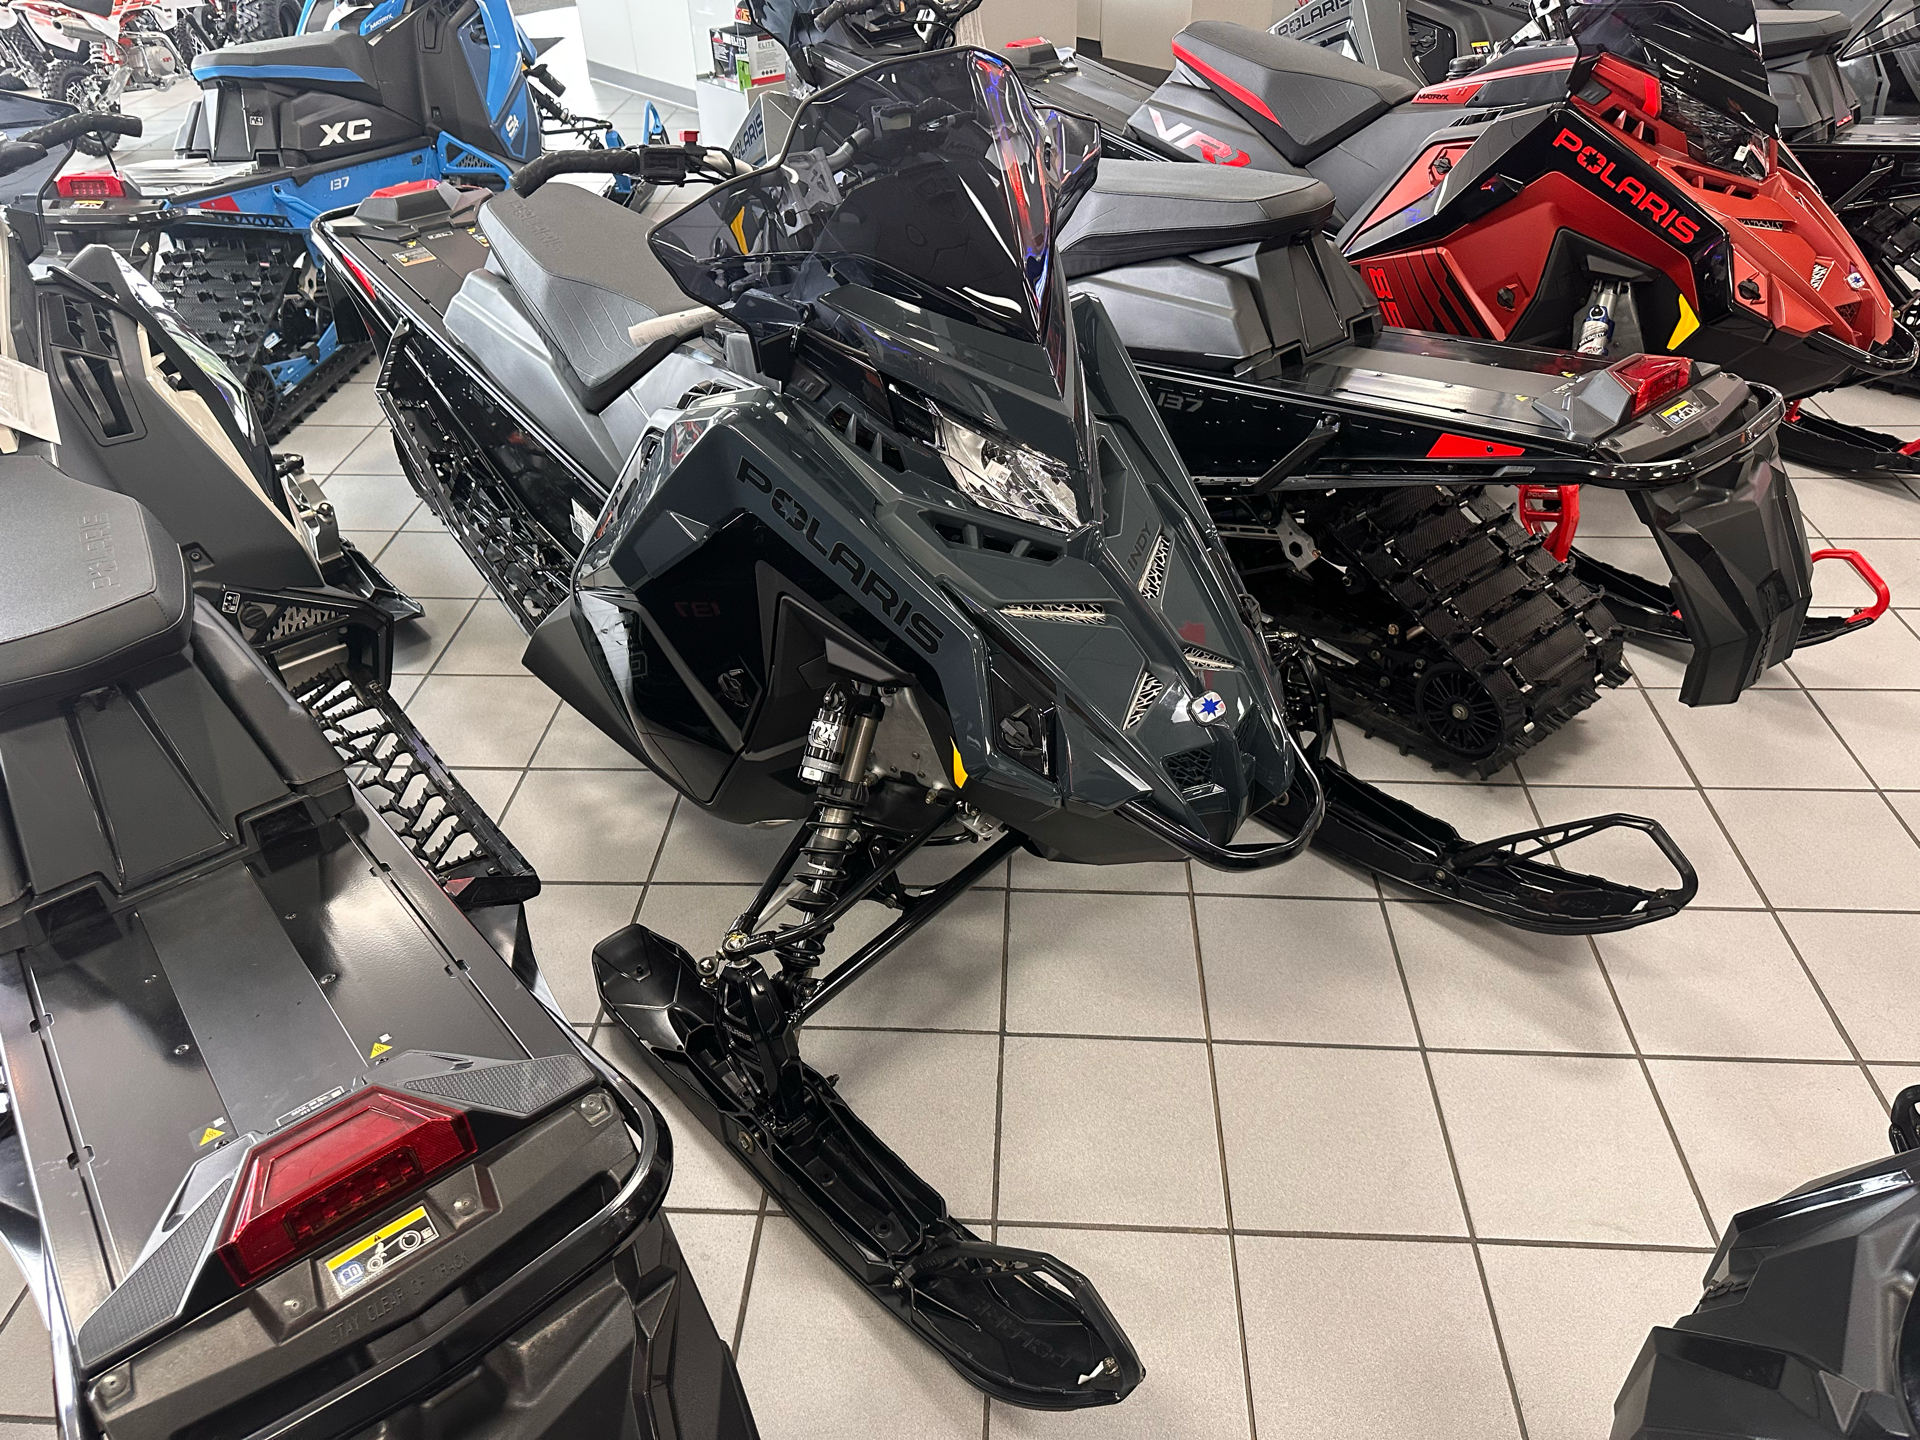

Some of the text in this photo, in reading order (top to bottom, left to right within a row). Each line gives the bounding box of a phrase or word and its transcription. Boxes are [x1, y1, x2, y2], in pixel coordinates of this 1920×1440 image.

[757, 40, 775, 49] ELITE
[1417, 93, 1449, 101] MATRYX
[319, 118, 372, 147] XC
[330, 176, 350, 191] 137
[1552, 127, 1701, 245] POLARIS
[1156, 391, 1204, 413] 137
[735, 455, 945, 655] POLARIS
[1126, 519, 1152, 572] INDY
